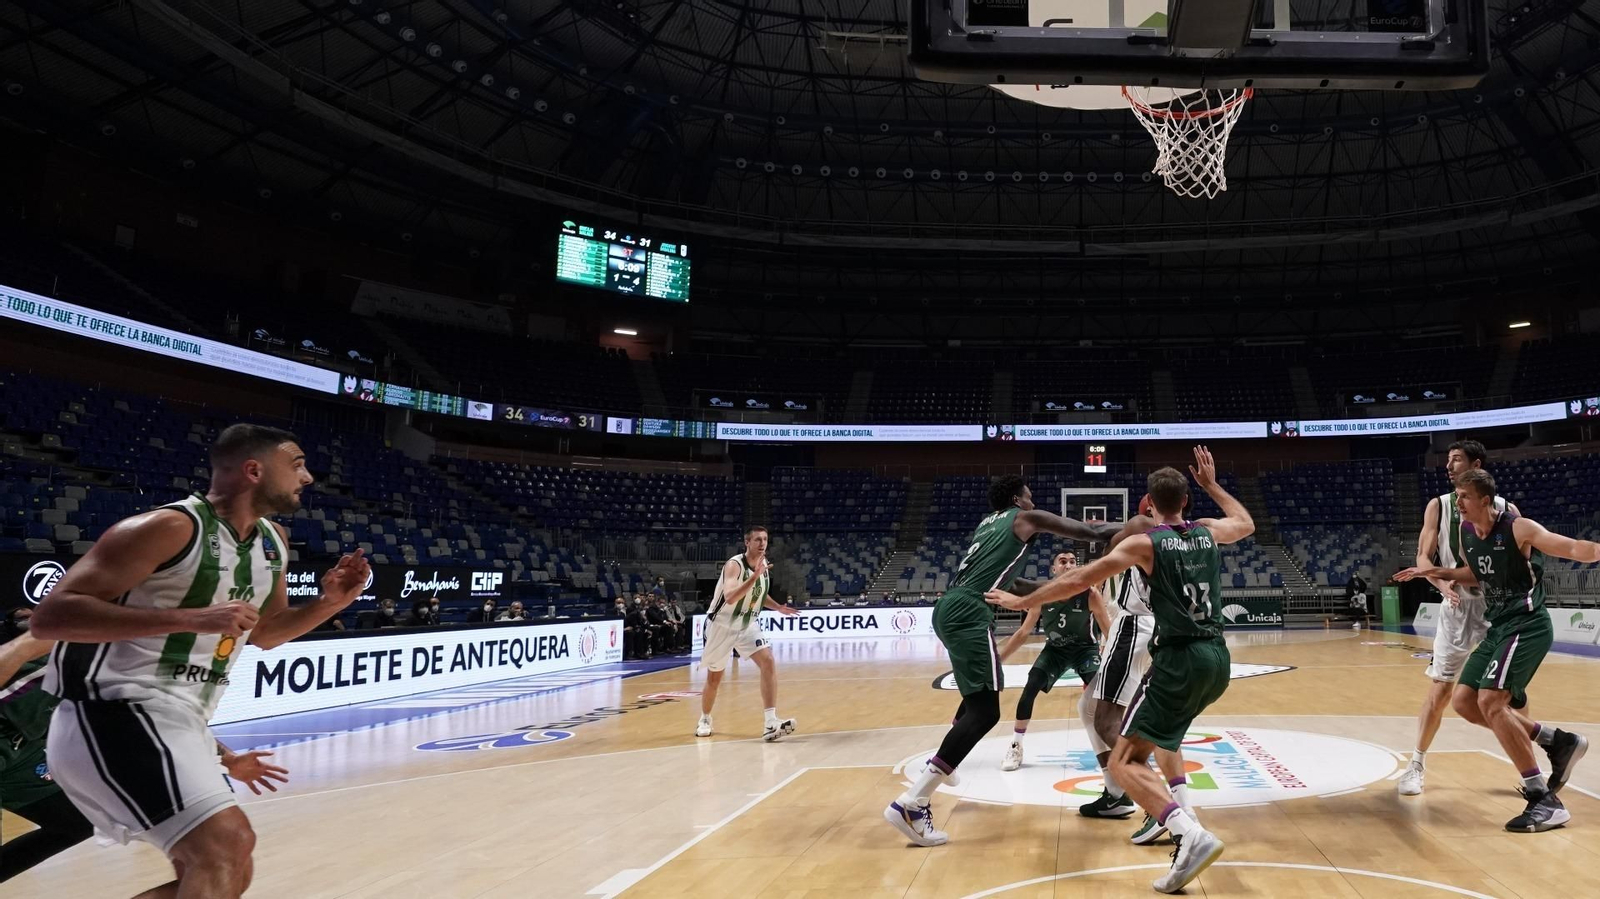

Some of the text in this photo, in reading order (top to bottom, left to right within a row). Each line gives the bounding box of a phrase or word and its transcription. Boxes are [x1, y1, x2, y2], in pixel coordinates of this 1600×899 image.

[1370, 16, 1409, 27] EuroCup
[604, 230, 617, 240] 34
[639, 237, 651, 248] 31
[632, 277, 640, 286] 4
[7, 296, 35, 315] TODO
[37, 303, 50, 319] LO
[53, 308, 73, 325] QUE
[76, 314, 89, 328] TE
[90, 317, 127, 338] OFRECE
[127, 327, 139, 341] LA
[141, 331, 171, 350] BANCA
[172, 338, 203, 356] DIGITAL
[505, 406, 524, 421] 34
[540, 414, 563, 423] EuroCup
[578, 415, 595, 428] 31
[1304, 424, 1333, 432] DESCUBRE
[1334, 423, 1348, 431] TODO
[1348, 423, 1357, 431] LO
[1357, 423, 1368, 431] QUE
[1369, 422, 1377, 430] TE
[1377, 421, 1399, 430] OFRECE
[1399, 421, 1408, 429] LA
[1408, 420, 1428, 429] BANCA
[1428, 418, 1450, 427] DIGITAL
[721, 427, 753, 436] DESCUBRE
[754, 428, 770, 436] TODO
[770, 429, 779, 437] LO
[779, 429, 791, 437] QUE
[792, 429, 799, 437] TE
[800, 429, 823, 437] OFRECE
[823, 429, 831, 437] LA
[831, 429, 852, 437] BANCA
[852, 429, 874, 437] DIGITAL
[1020, 428, 1048, 437] DESCUBRE
[1049, 428, 1064, 436] TODO
[1064, 428, 1072, 436] LO
[1072, 428, 1083, 436] QUE
[1084, 428, 1091, 436] TE
[1091, 428, 1113, 436] OFRECE
[1113, 428, 1121, 436] LA
[1120, 427, 1140, 436] BANCA
[1140, 427, 1161, 436] DIGITAL
[1087, 454, 1102, 467] 11
[1477, 555, 1495, 575] 52
[32, 566, 58, 598] 7
[42, 570, 63, 596] DAYS
[299, 571, 316, 583] del
[1183, 581, 1213, 621] 23
[764, 614, 879, 634] ANTEQUERA
[1057, 613, 1067, 629] 3
[1246, 612, 1282, 624] Unicaja
[254, 648, 402, 699] MOLLETE
[411, 644, 444, 678] DE
[449, 633, 570, 673] ANTEQUERA
[1092, 655, 1101, 666] 3
